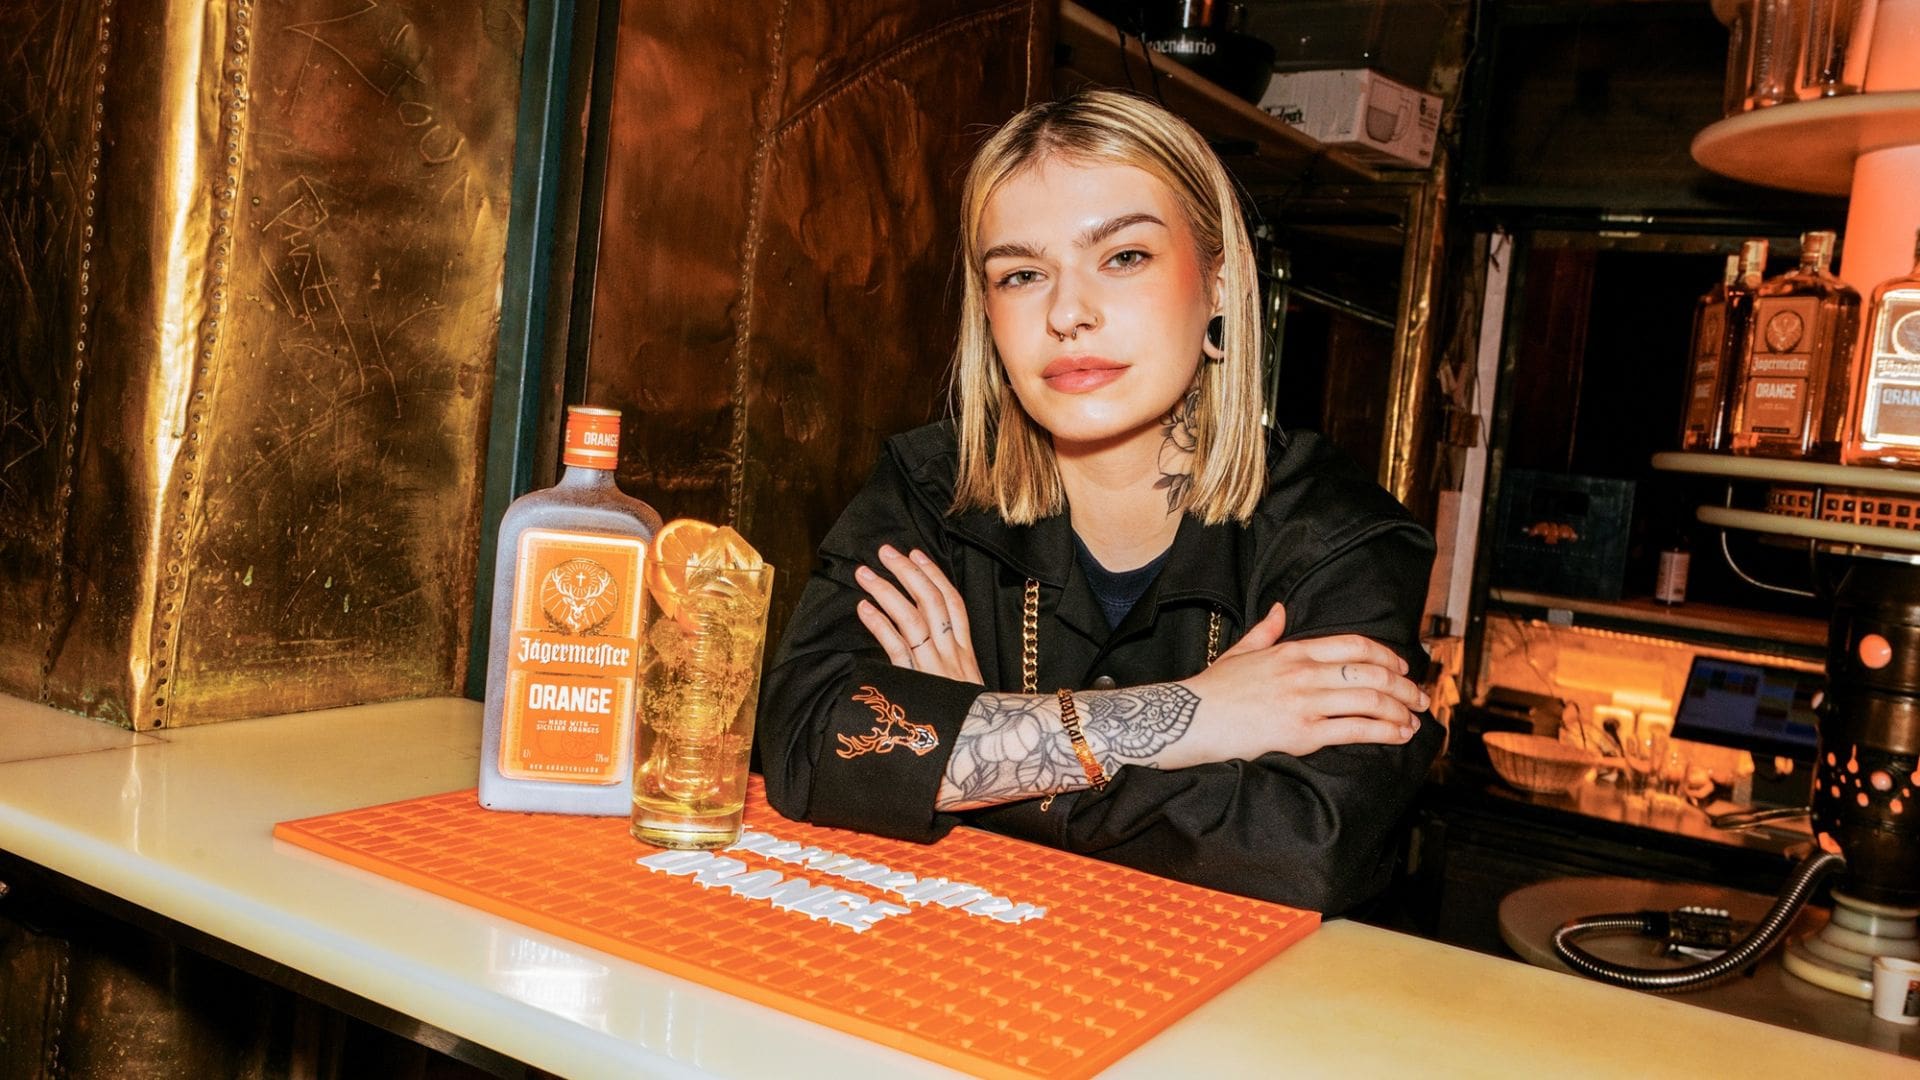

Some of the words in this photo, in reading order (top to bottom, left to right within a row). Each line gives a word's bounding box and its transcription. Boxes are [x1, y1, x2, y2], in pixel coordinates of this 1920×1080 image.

[1755, 383, 1797, 399] ORANGE
[583, 431, 620, 448] ORANGE
[518, 636, 630, 669] Jägermeister
[528, 683, 613, 714] ORANGE
[536, 724, 566, 732] SICILIAN
[568, 726, 600, 734] ORANGES
[548, 719, 567, 727] MADE
[570, 720, 589, 728] WITH
[636, 849, 913, 934] ORANGE
